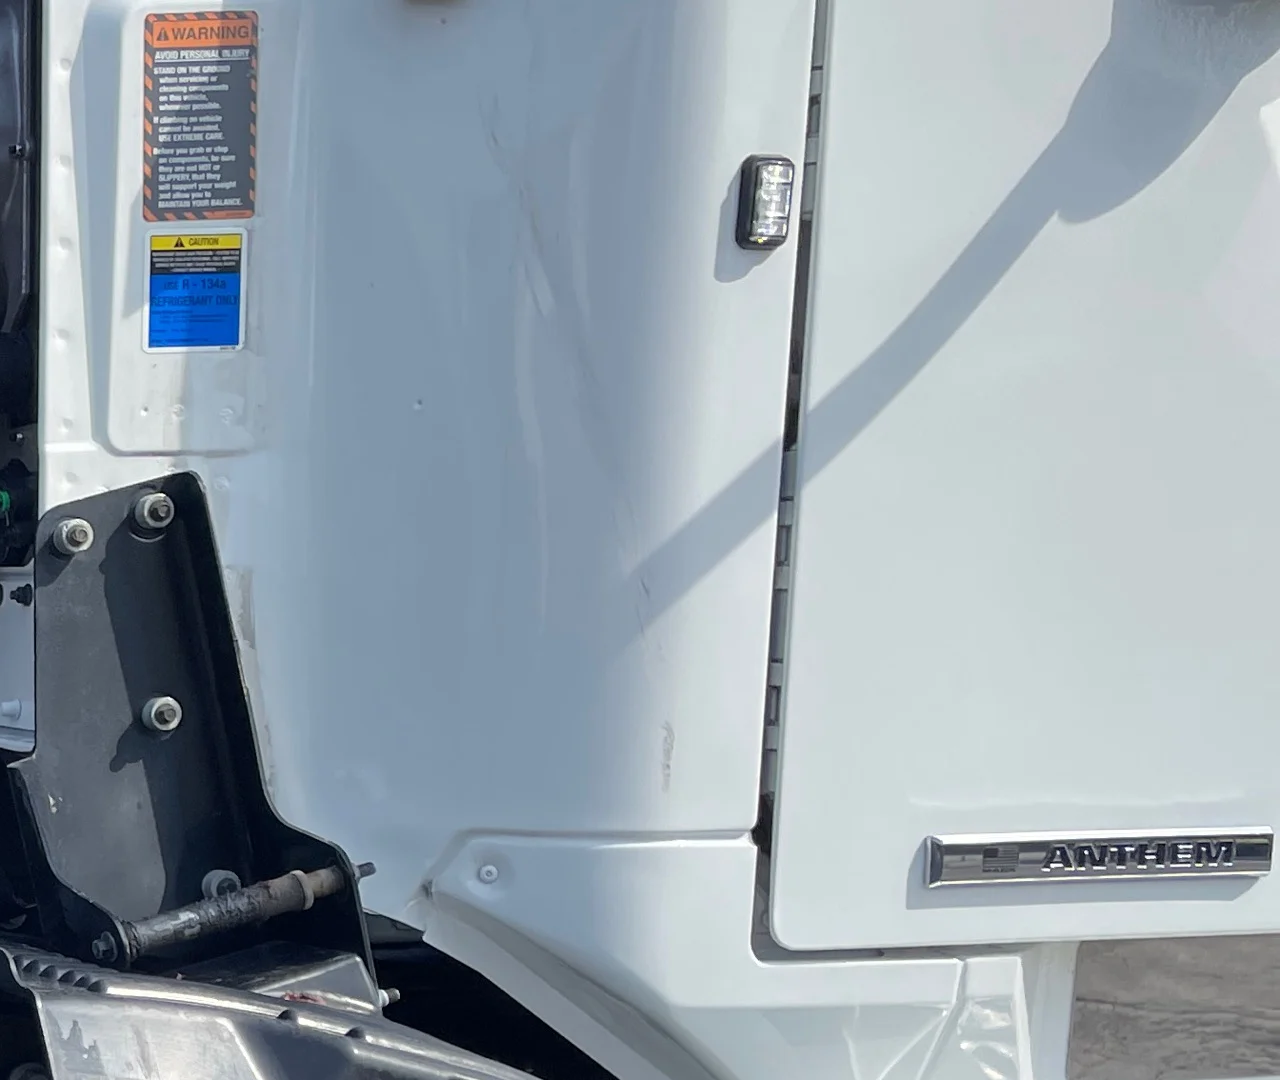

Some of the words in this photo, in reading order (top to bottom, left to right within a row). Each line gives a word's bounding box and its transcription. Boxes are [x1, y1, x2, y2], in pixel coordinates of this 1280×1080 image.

[172, 26, 250, 40] WARNING
[155, 50, 179, 60] AVOID
[180, 49, 219, 59] PERSONAL
[154, 66, 176, 74] STAND
[177, 66, 187, 74] ON
[159, 134, 171, 142] USE
[173, 133, 204, 142] EXTREME
[192, 200, 209, 208] YOUR
[188, 237, 219, 246] CAUTION
[201, 278, 227, 289] 134a
[151, 295, 213, 307] REFRIGERANT
[215, 294, 239, 306] ONLY
[1040, 840, 1236, 872] ANTHEM
